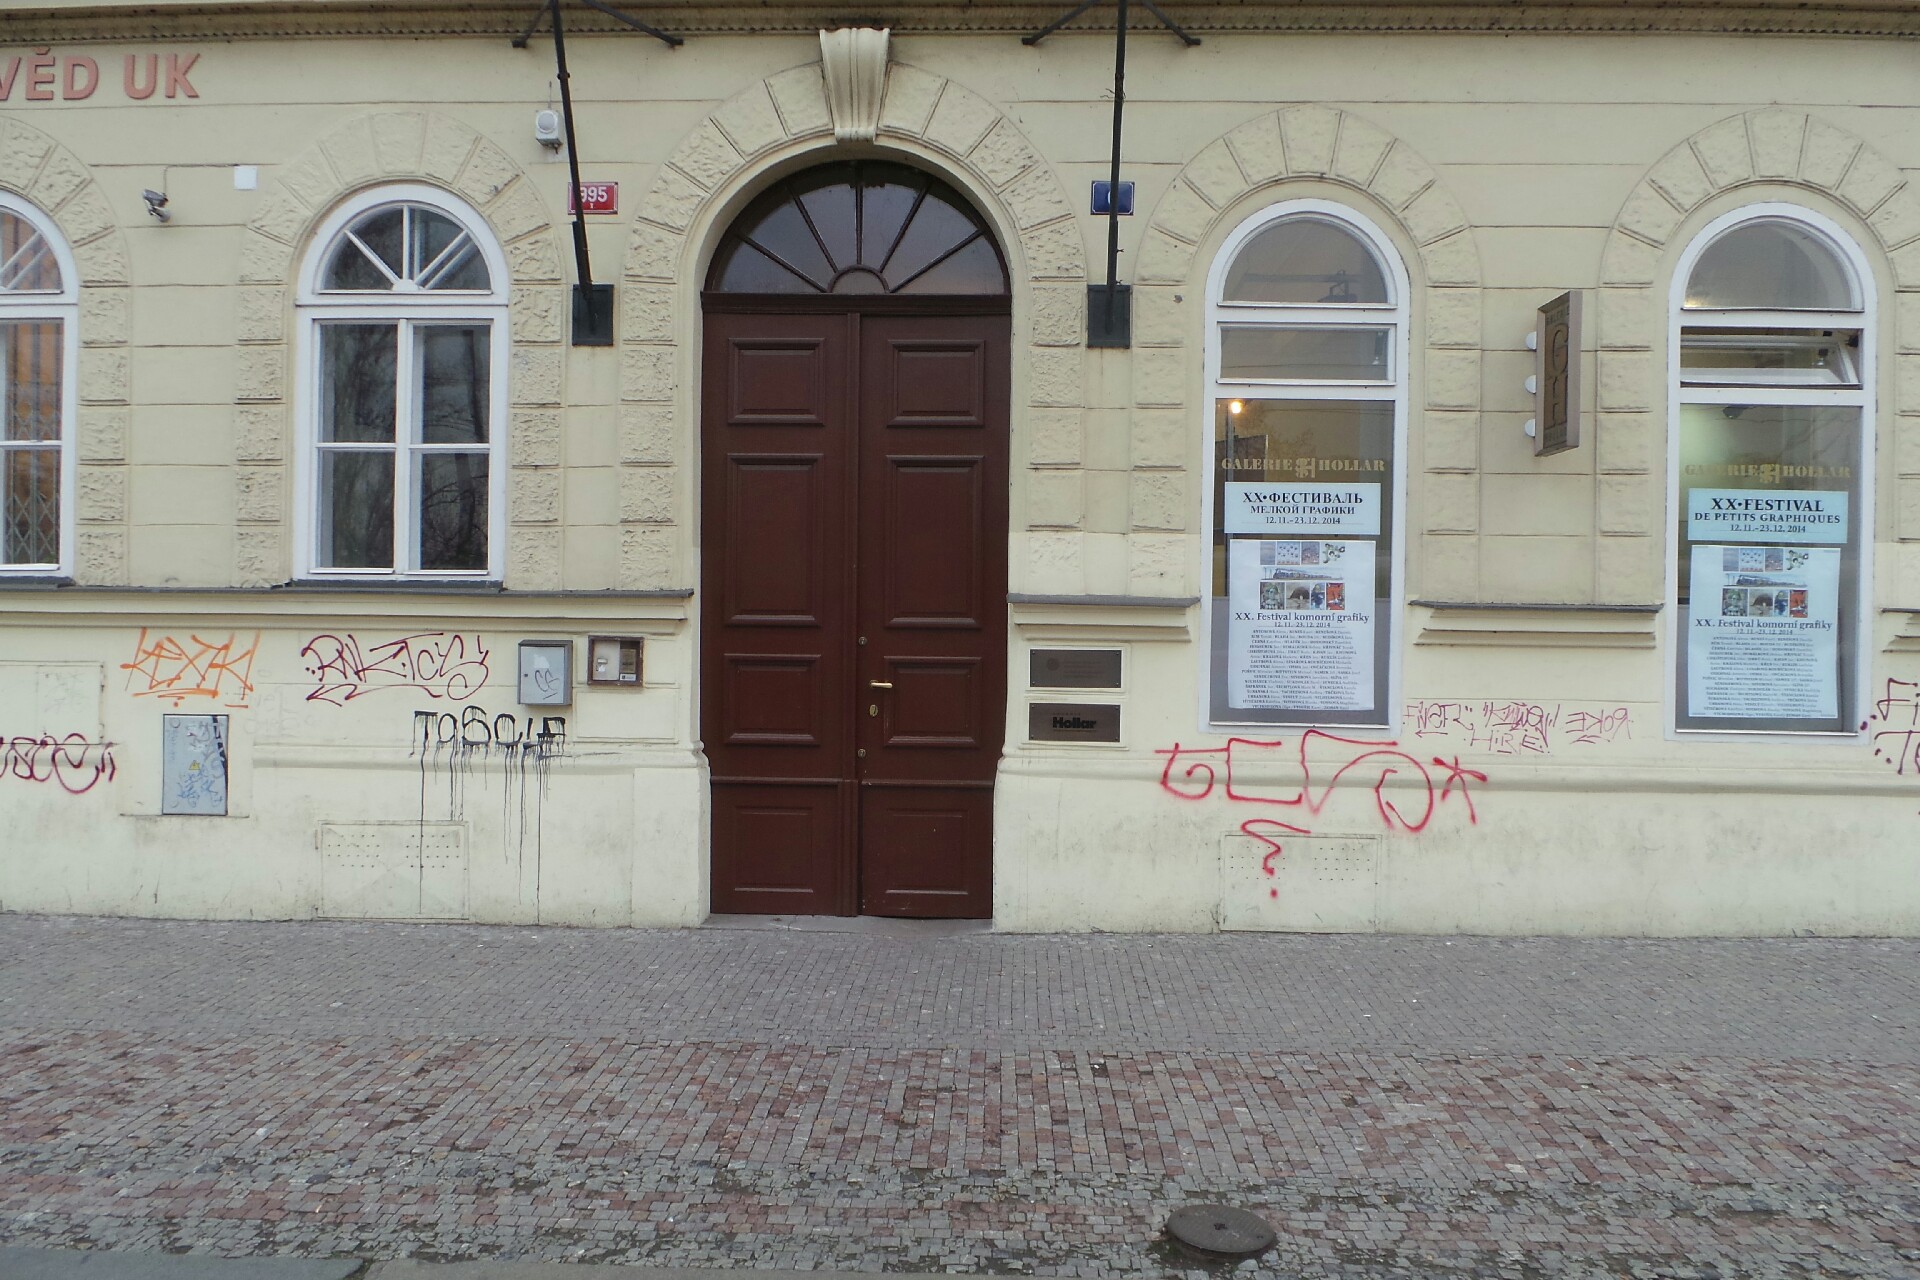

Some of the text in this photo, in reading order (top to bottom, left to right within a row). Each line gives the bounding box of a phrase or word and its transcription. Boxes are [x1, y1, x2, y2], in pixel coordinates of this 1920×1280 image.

[123, 53, 200, 100] UK
[1221, 457, 1386, 472] GALERIE HOLLAR
[1783, 465, 1850, 478] HOLLAR
[1250, 504, 1355, 515] МЕЛКОЙ ГРАФИКИ
[1322, 516, 1341, 525] 2014
[1694, 512, 1841, 524] DE PETITS GRAPHIQUES
[1787, 525, 1806, 533] 2014
[1234, 612, 1370, 623] XX. Festival komorní grafiky
[1695, 618, 1833, 631] XX. Festival komorní grafiky
[1052, 717, 1097, 729] Hollar
